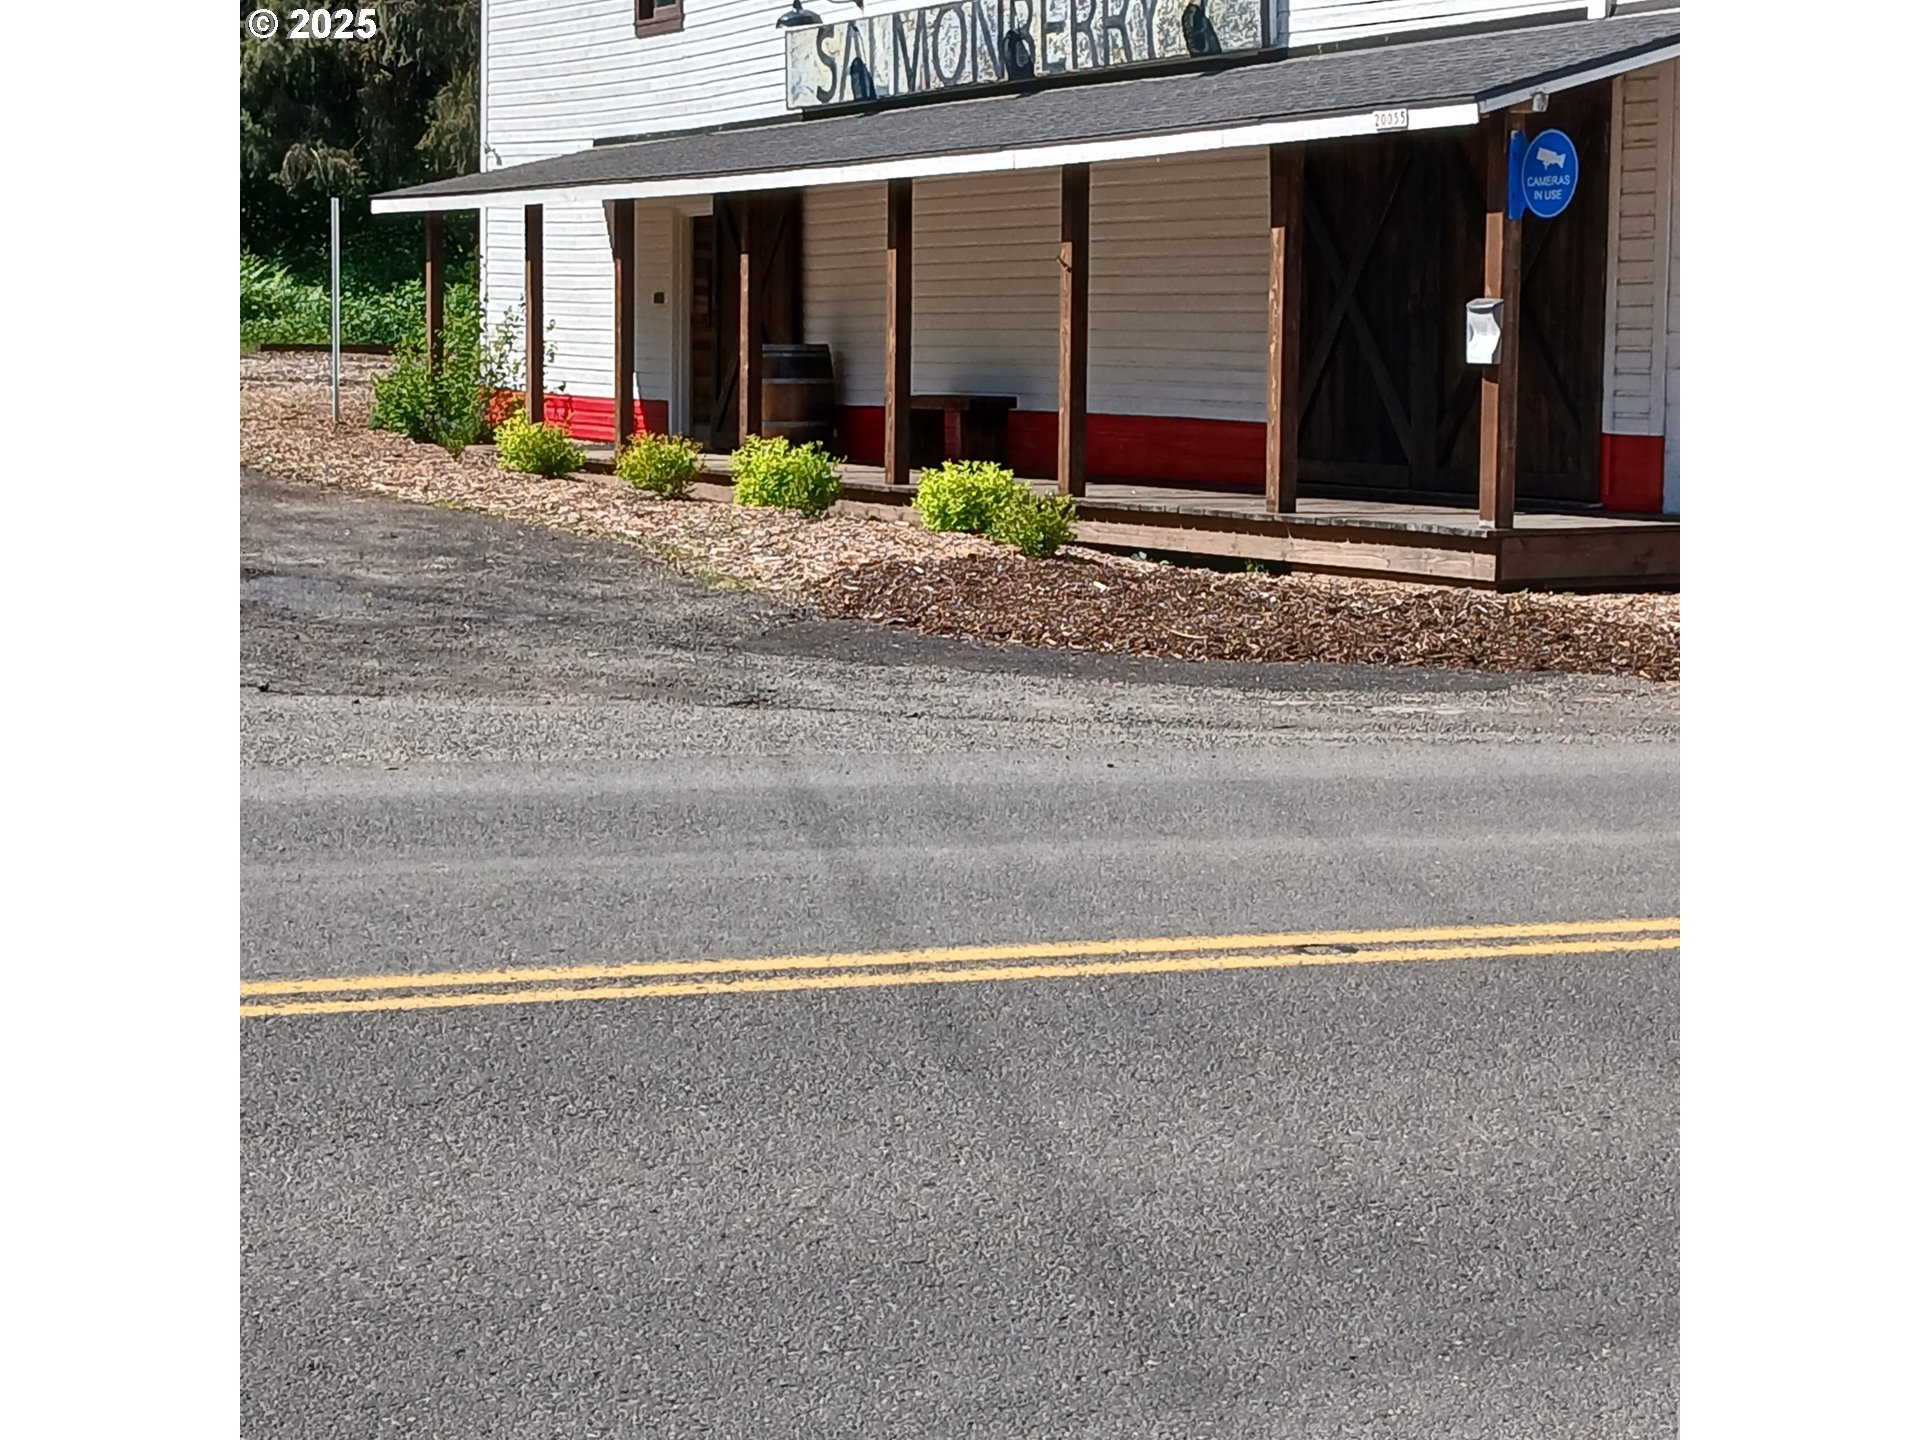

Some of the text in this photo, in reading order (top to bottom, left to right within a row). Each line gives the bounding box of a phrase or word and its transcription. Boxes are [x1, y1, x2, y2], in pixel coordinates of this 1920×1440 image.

[1374, 110, 1406, 127] 20055
[1527, 174, 1571, 187] CAMERAS
[1533, 189, 1562, 200] IN USE
